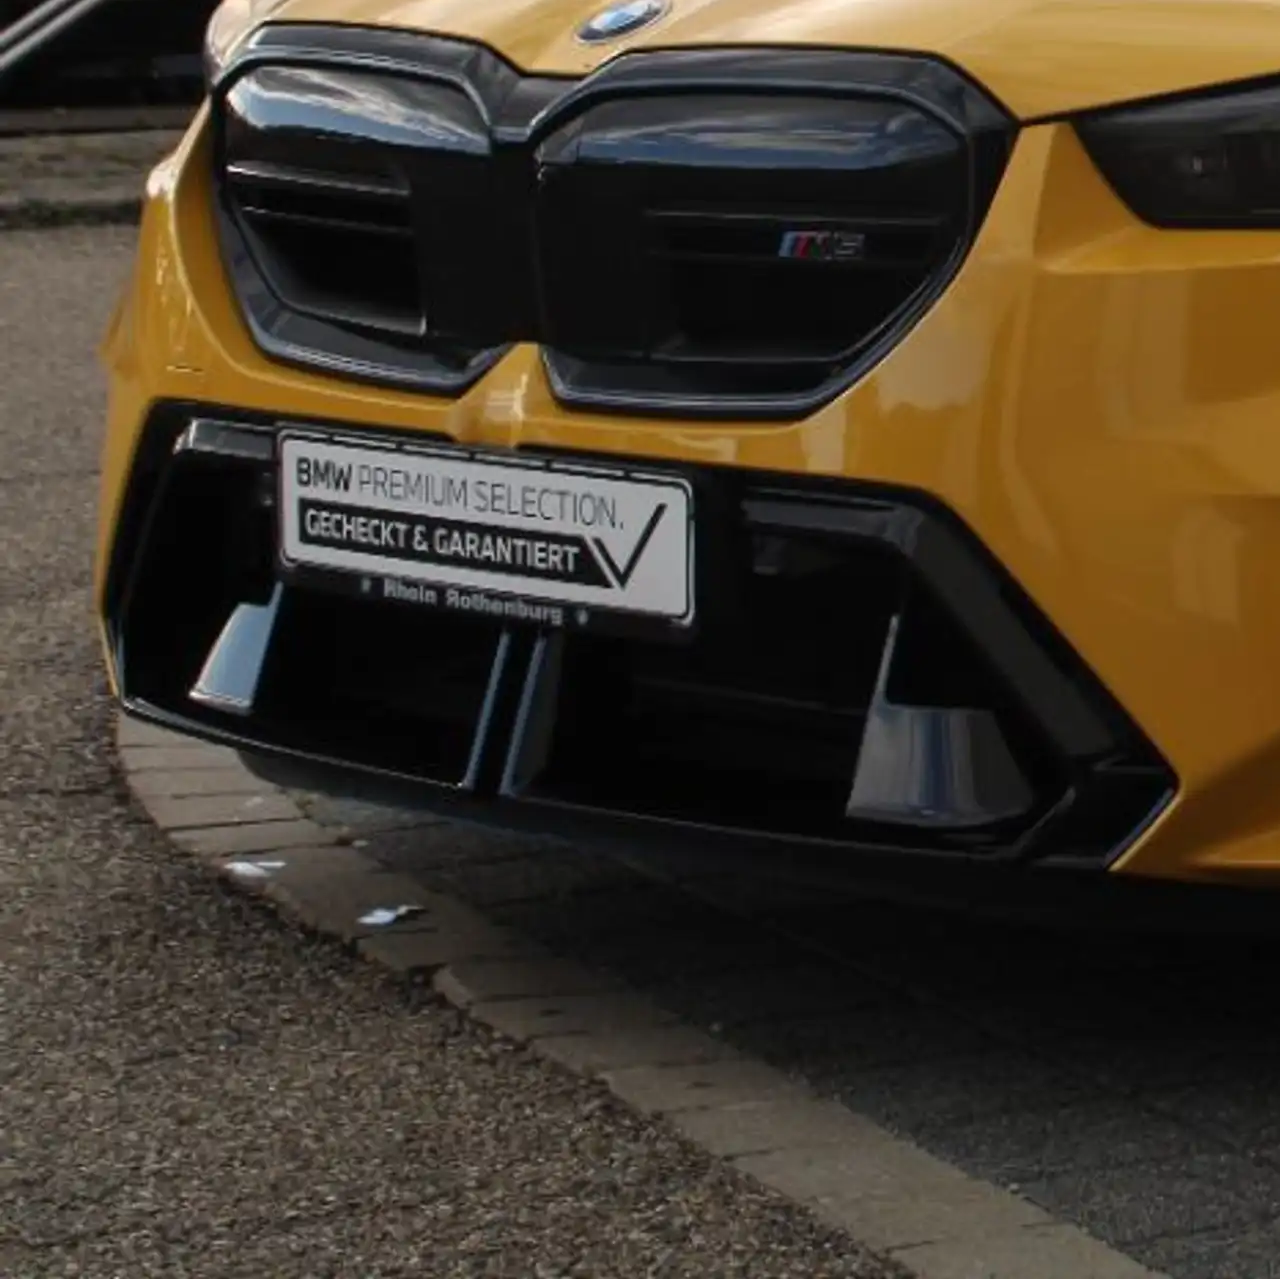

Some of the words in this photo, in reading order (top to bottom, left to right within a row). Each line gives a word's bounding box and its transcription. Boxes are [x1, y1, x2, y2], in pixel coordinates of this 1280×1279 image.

[297, 456, 352, 493] BMW
[358, 464, 468, 511] PREMIUM
[304, 507, 410, 549] GECHECKT
[412, 525, 429, 553] &
[433, 527, 580, 573] GARANTIERT
[445, 587, 564, 626] Rothenburg
